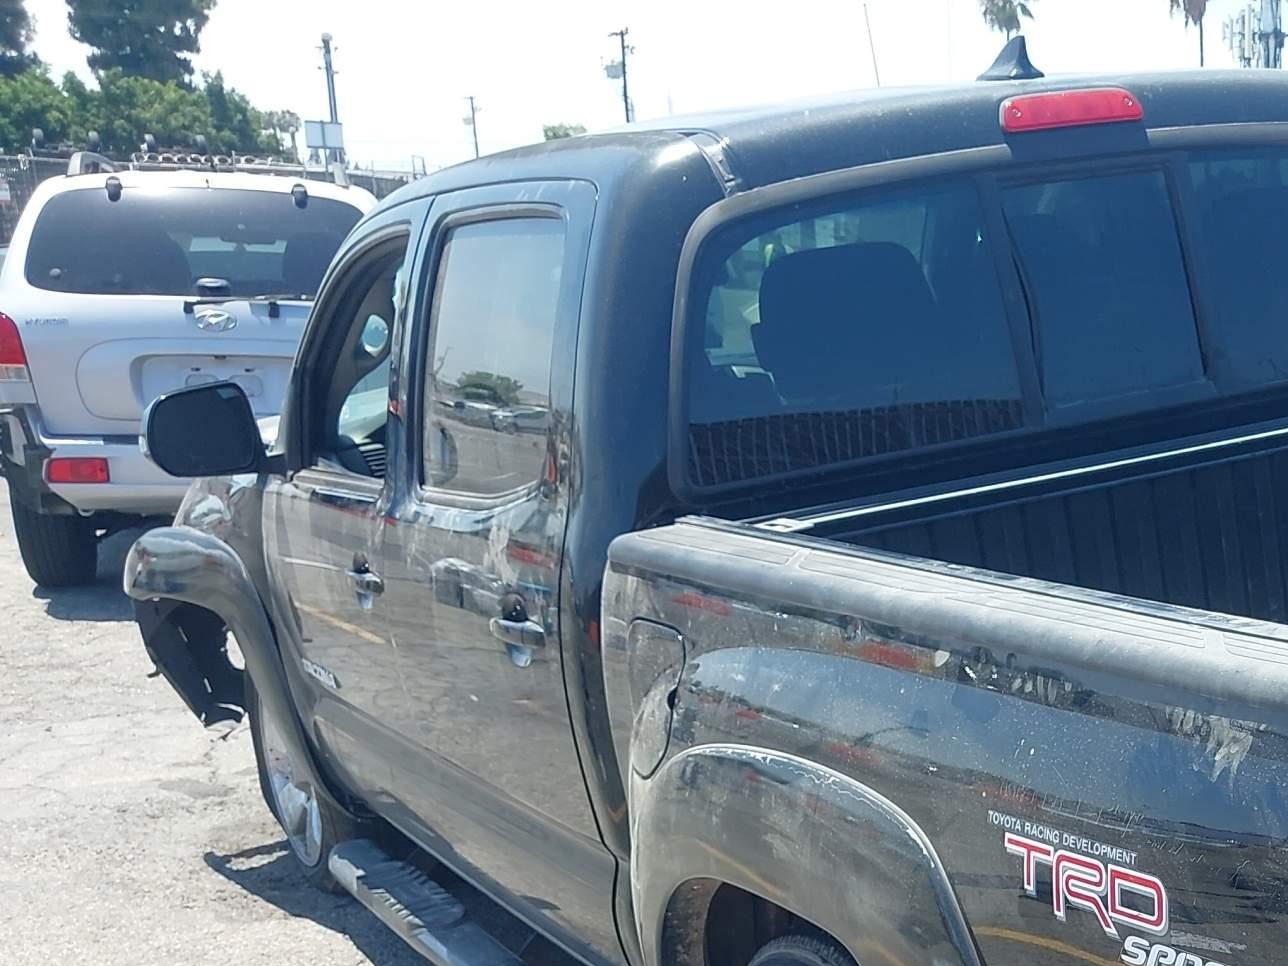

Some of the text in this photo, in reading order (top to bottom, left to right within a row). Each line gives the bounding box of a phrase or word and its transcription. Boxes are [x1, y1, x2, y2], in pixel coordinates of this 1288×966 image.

[988, 810, 1137, 865] TOYOTA RACING DEVELOPMENT
[1004, 831, 1169, 939] TRD
